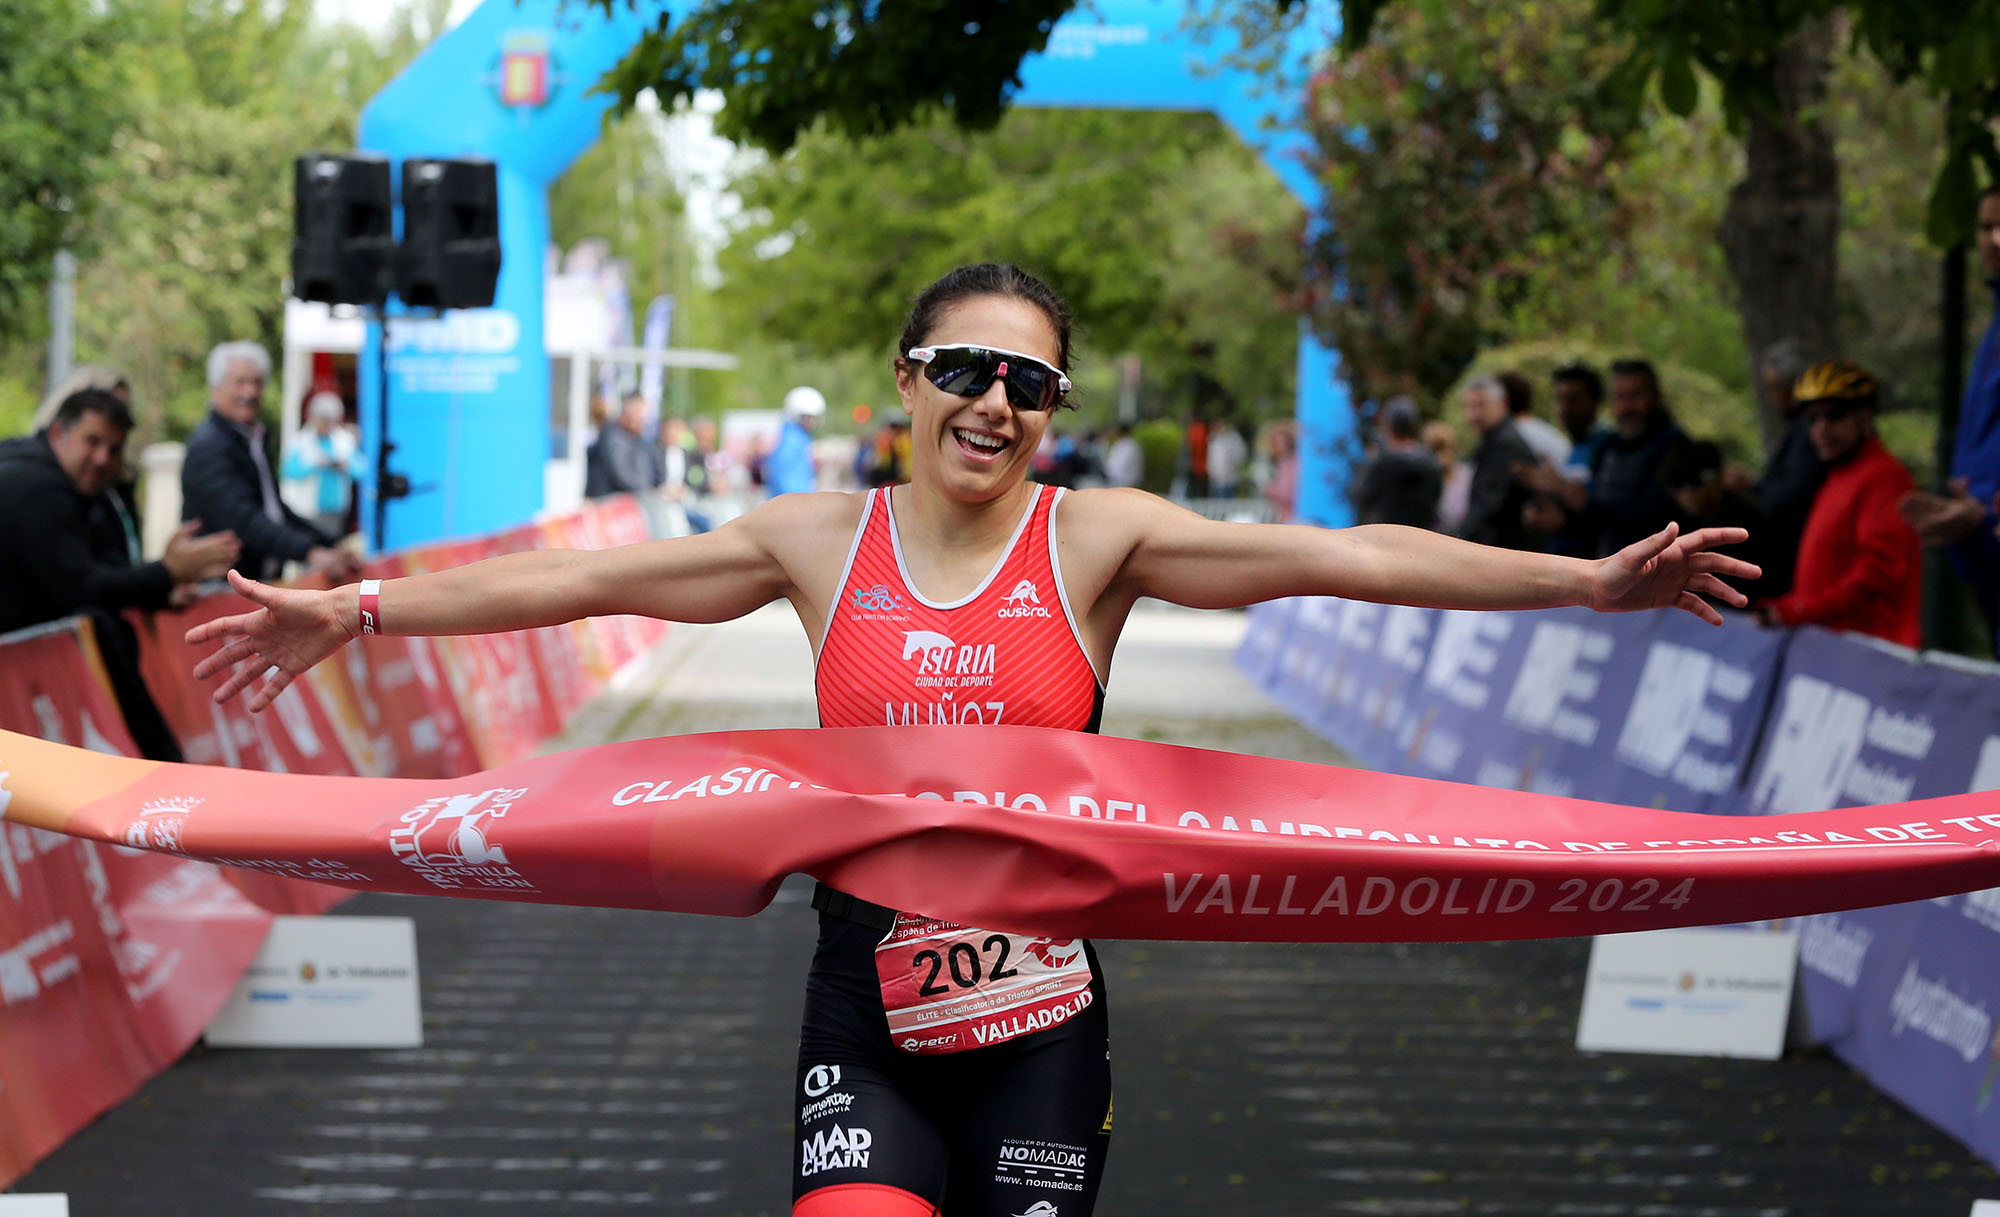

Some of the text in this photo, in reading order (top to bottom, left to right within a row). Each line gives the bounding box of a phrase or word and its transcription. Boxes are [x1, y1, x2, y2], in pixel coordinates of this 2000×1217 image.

[998, 607, 1052, 618] austral
[915, 676, 994, 688] CIUDAD DEL DEPORTE
[1864, 822, 1948, 842] DE
[307, 858, 349, 869] de
[434, 867, 522, 877] CASTILLA
[1162, 872, 1696, 916] VALLADOLID 2024
[926, 924, 939, 933] de
[912, 934, 1018, 997] 202
[945, 999, 995, 1016] Clasificatorio
[996, 996, 1006, 1004] de
[1035, 980, 1063, 994] SPRINT
[971, 990, 1093, 1044] VALLADOLID
[802, 1123, 872, 1164] MAD
[1000, 1146, 1086, 1167] NOMADAC
[1025, 1178, 1083, 1191] nomadac.es
